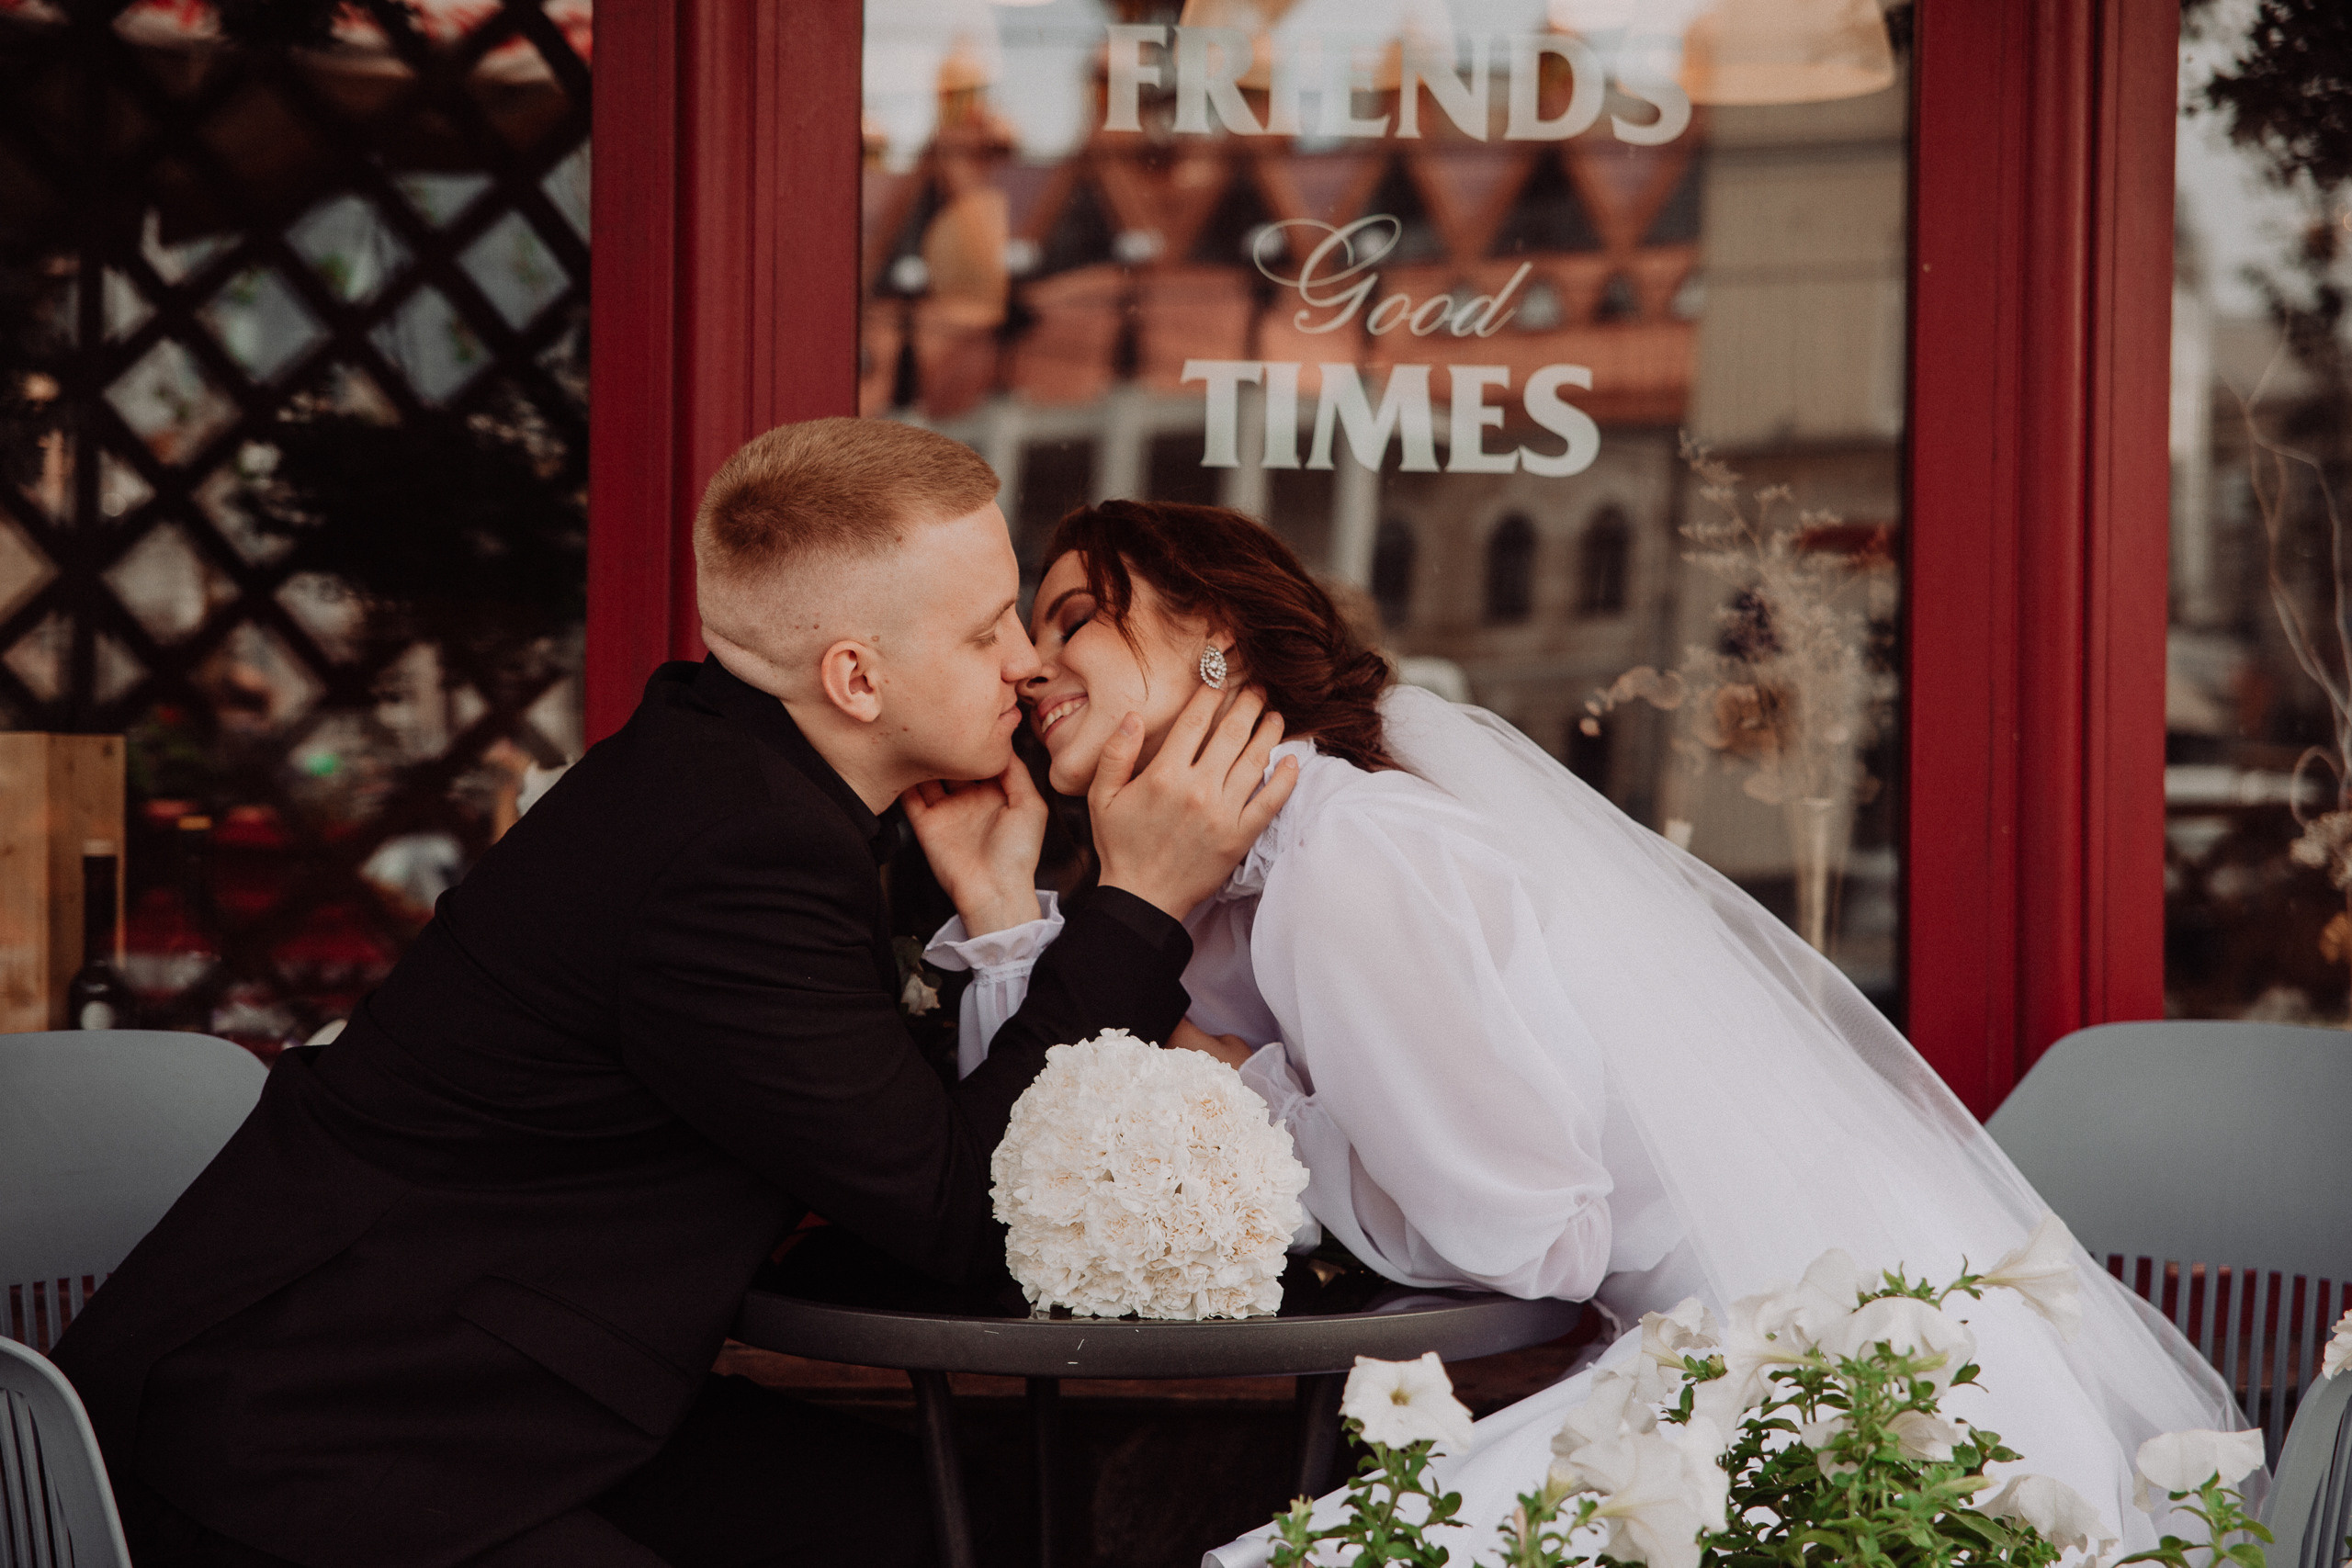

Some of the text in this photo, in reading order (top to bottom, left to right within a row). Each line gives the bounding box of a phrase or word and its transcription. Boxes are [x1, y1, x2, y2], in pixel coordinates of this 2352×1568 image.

[1104, 24, 1692, 145] FRIENDS
[1253, 214, 1533, 338] Good
[1180, 359, 1600, 478] TIMES
